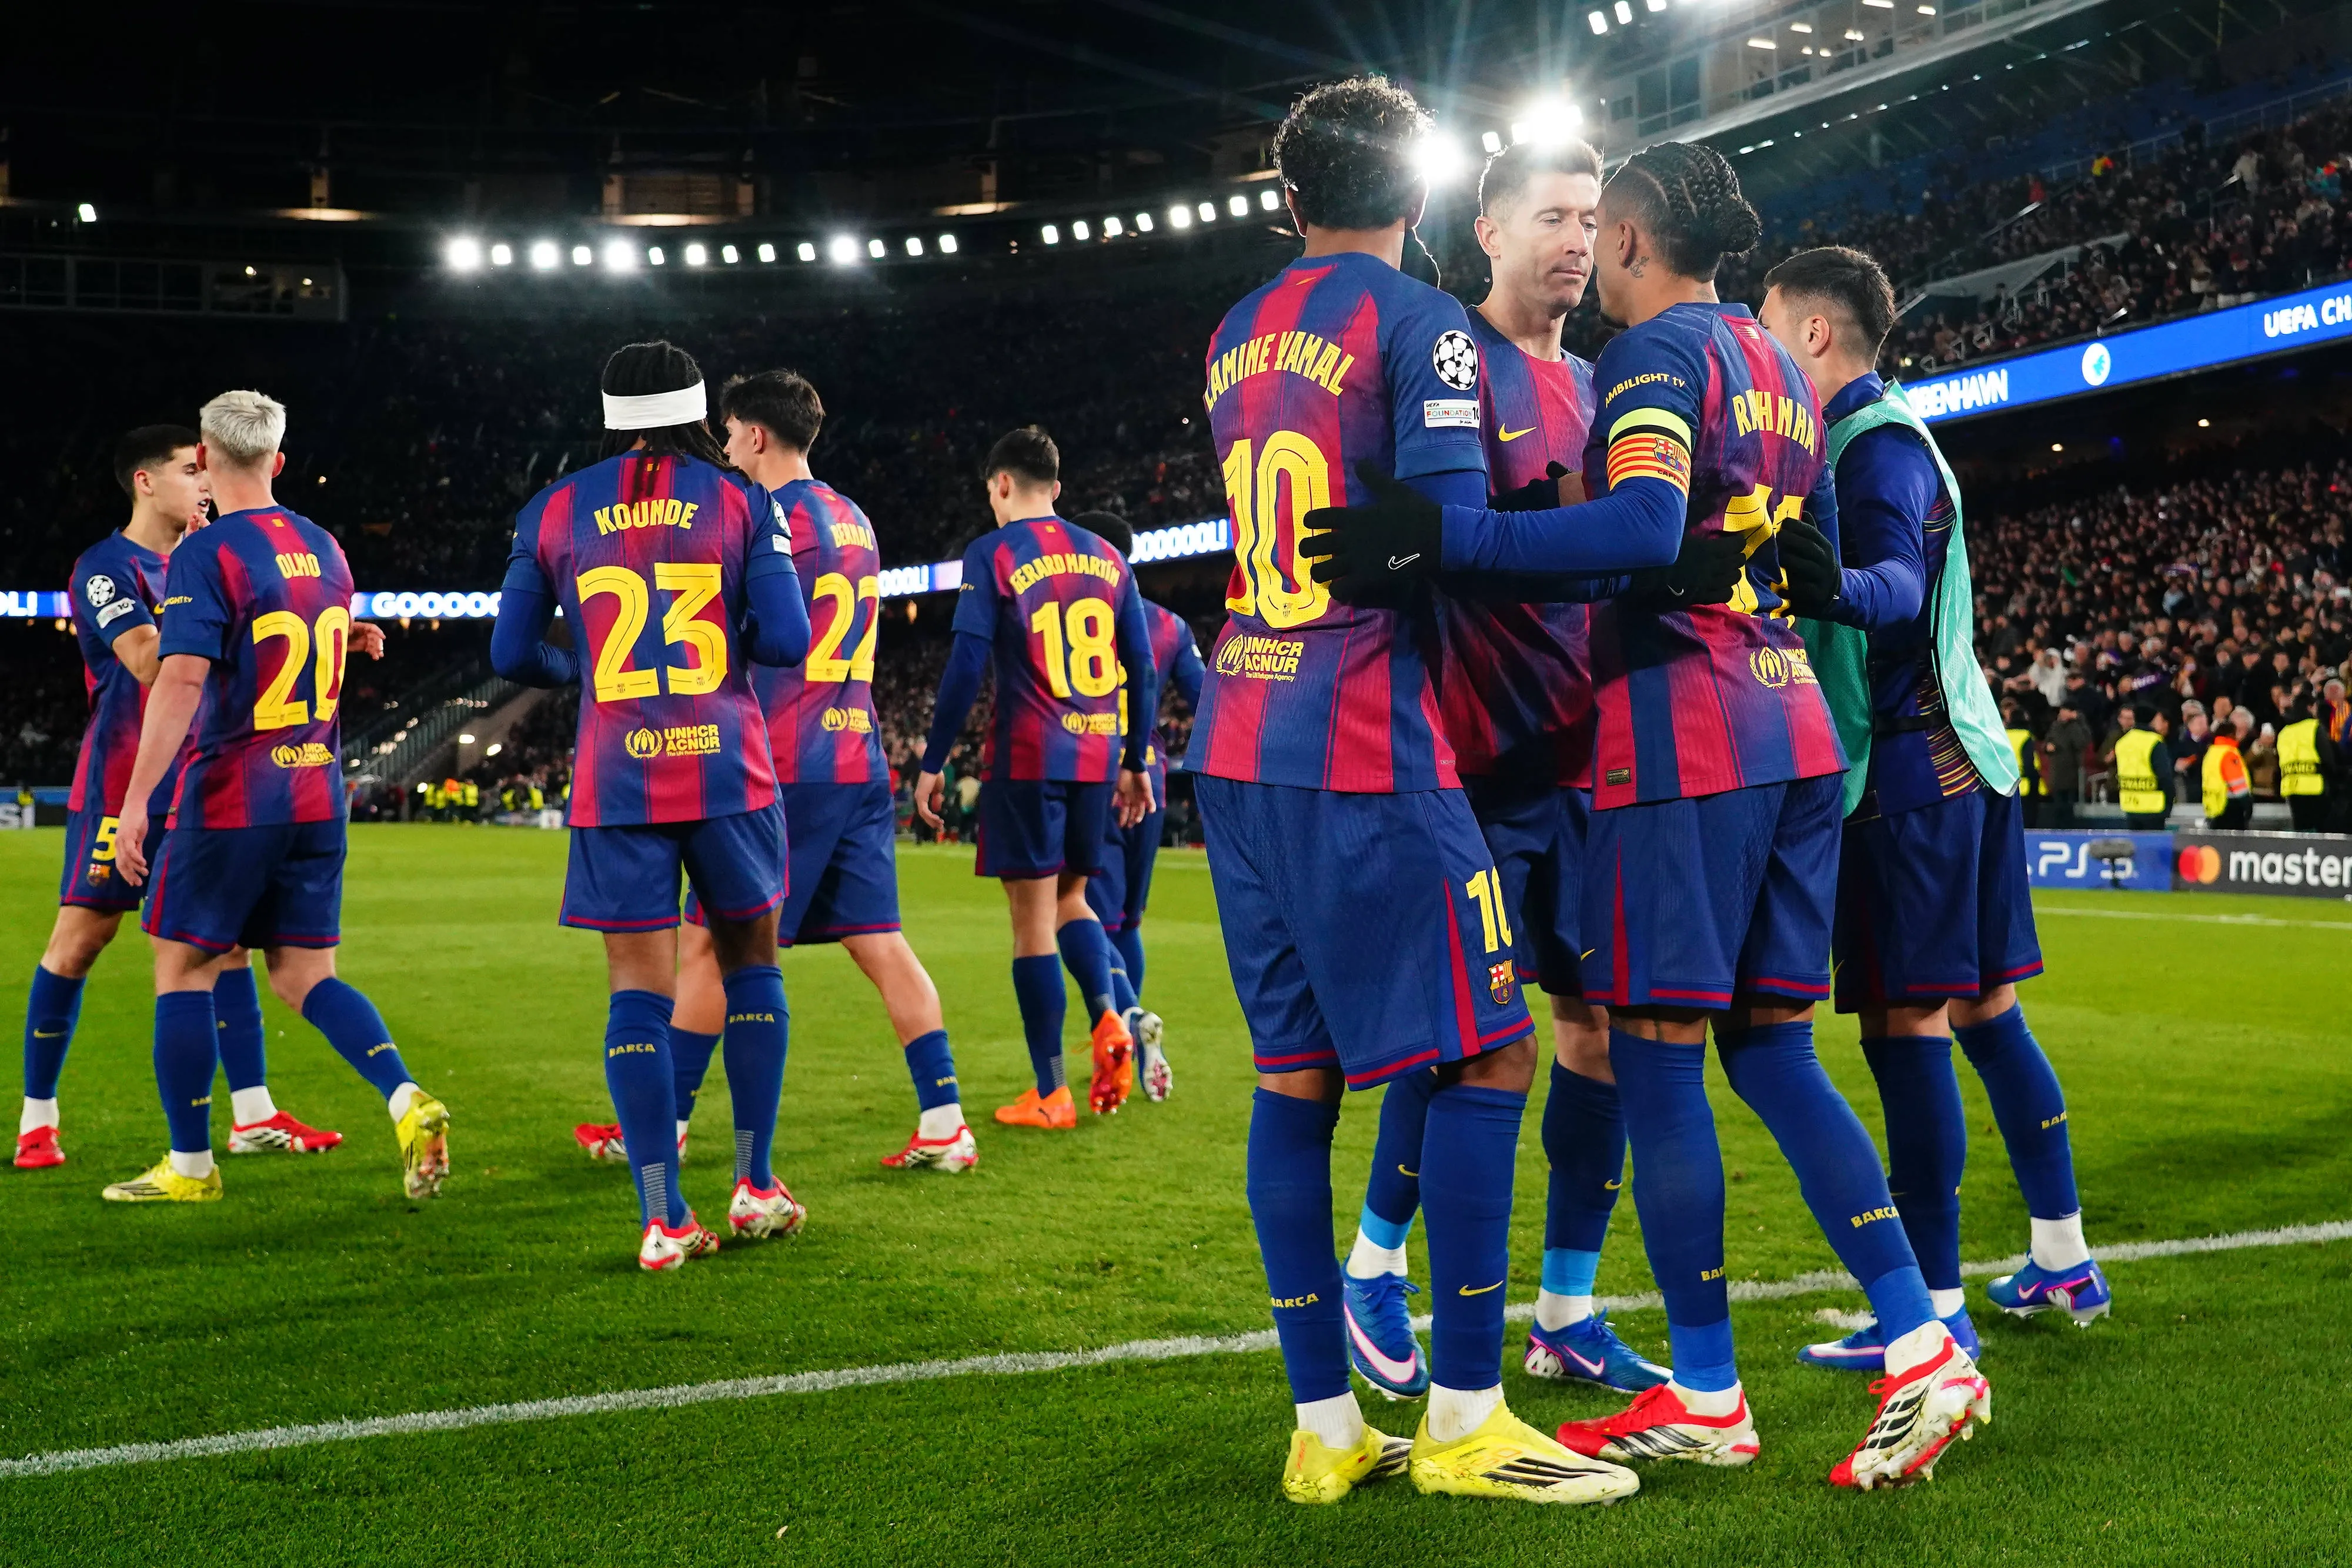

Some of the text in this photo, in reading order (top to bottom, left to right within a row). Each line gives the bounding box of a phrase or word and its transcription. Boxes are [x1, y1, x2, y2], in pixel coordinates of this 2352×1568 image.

[2264, 303, 2318, 337] UEFA
[1274, 331, 1355, 396] YAMAL
[1605, 373, 1686, 409] AMBILIGHT tv
[594, 499, 699, 536] KOUNDE
[1222, 430, 1332, 628] 10
[276, 553, 321, 579] OLMO
[1009, 554, 1066, 595] GERARD
[576, 562, 728, 703] 23
[806, 572, 880, 683] 22
[1244, 637, 1304, 657] UNHCR
[1031, 597, 1118, 698] 18
[1245, 654, 1299, 673] ACNUR
[252, 606, 351, 730] 20
[664, 724, 719, 740] UNHCR
[666, 736, 720, 752] ACNUR
[92, 816, 119, 861] 5
